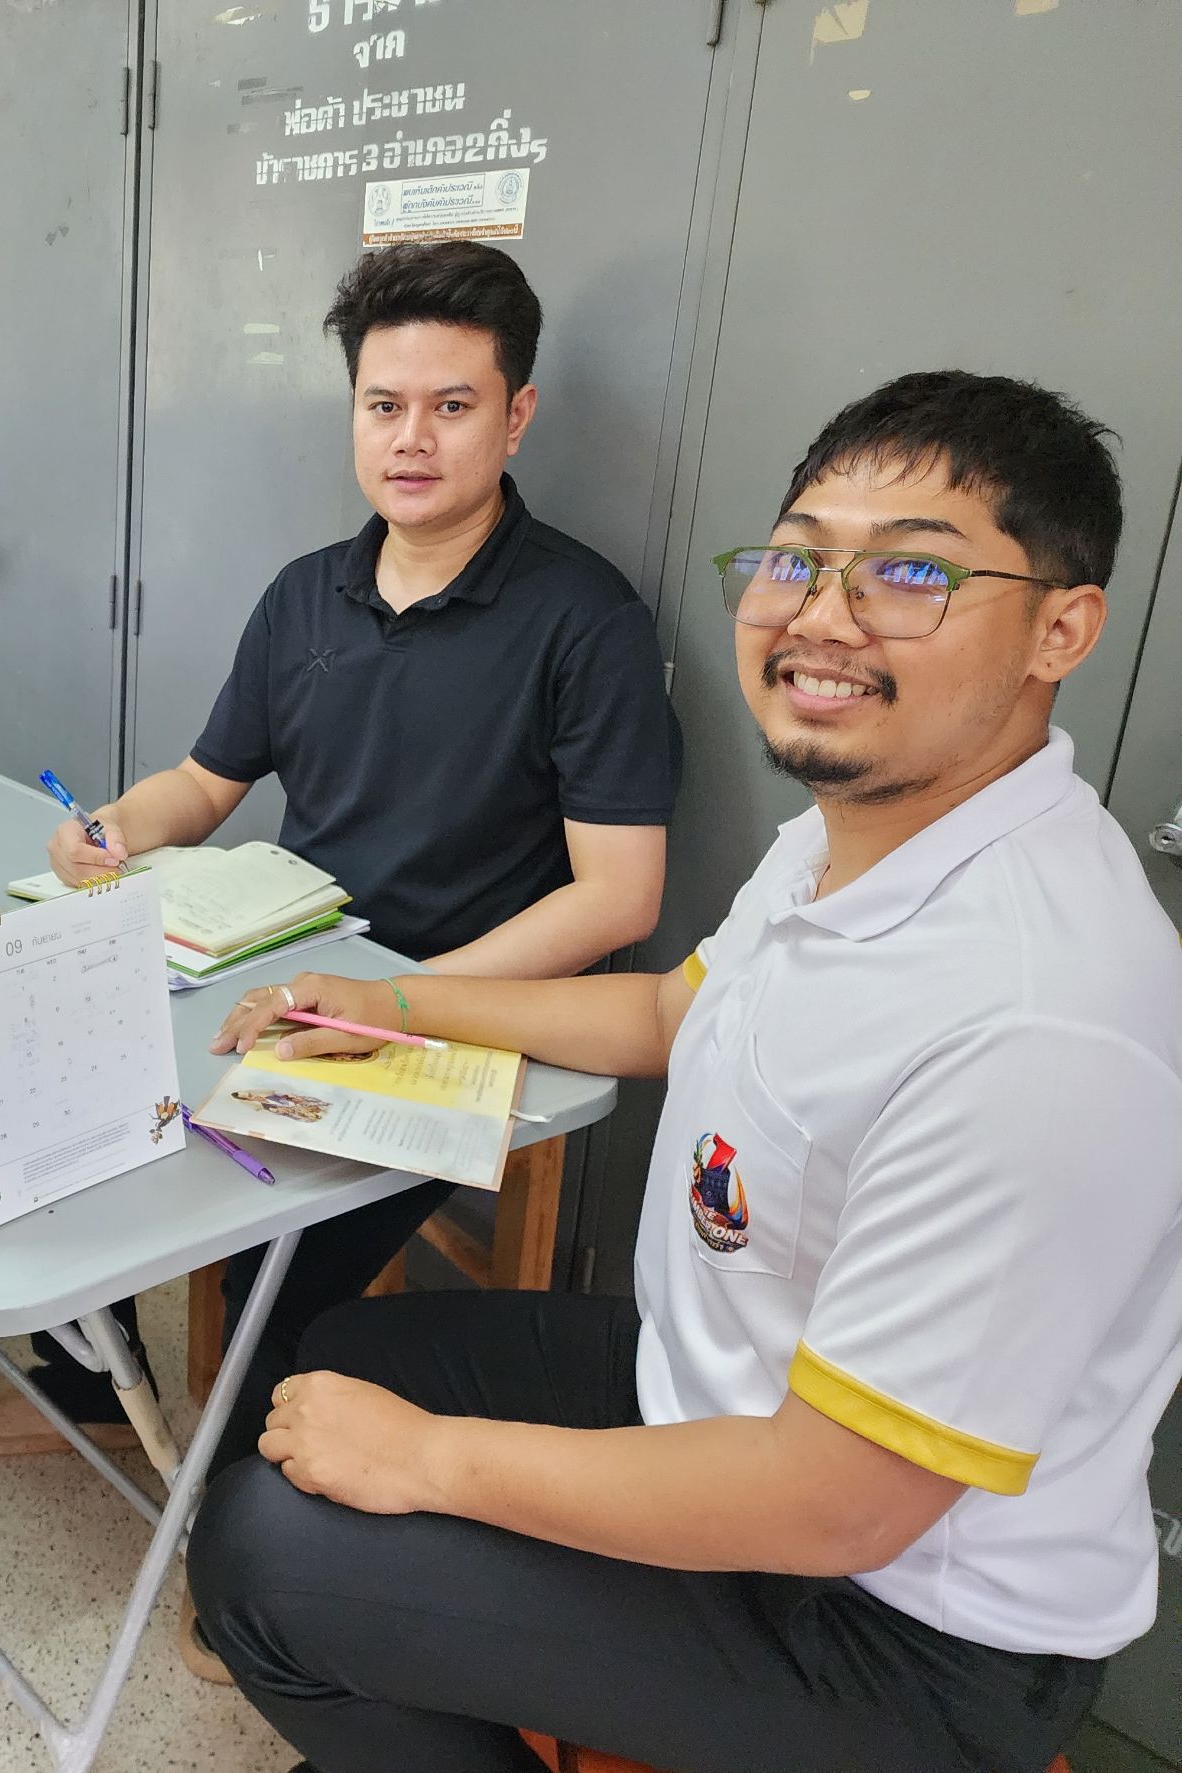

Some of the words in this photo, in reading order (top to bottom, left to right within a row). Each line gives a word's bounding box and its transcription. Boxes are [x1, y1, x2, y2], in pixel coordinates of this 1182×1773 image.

[353, 29, 406, 68] จาก
[284, 96, 345, 136] พ่อค้า
[352, 86, 466, 126] ประชาชน
[5, 938, 23, 957] 09
